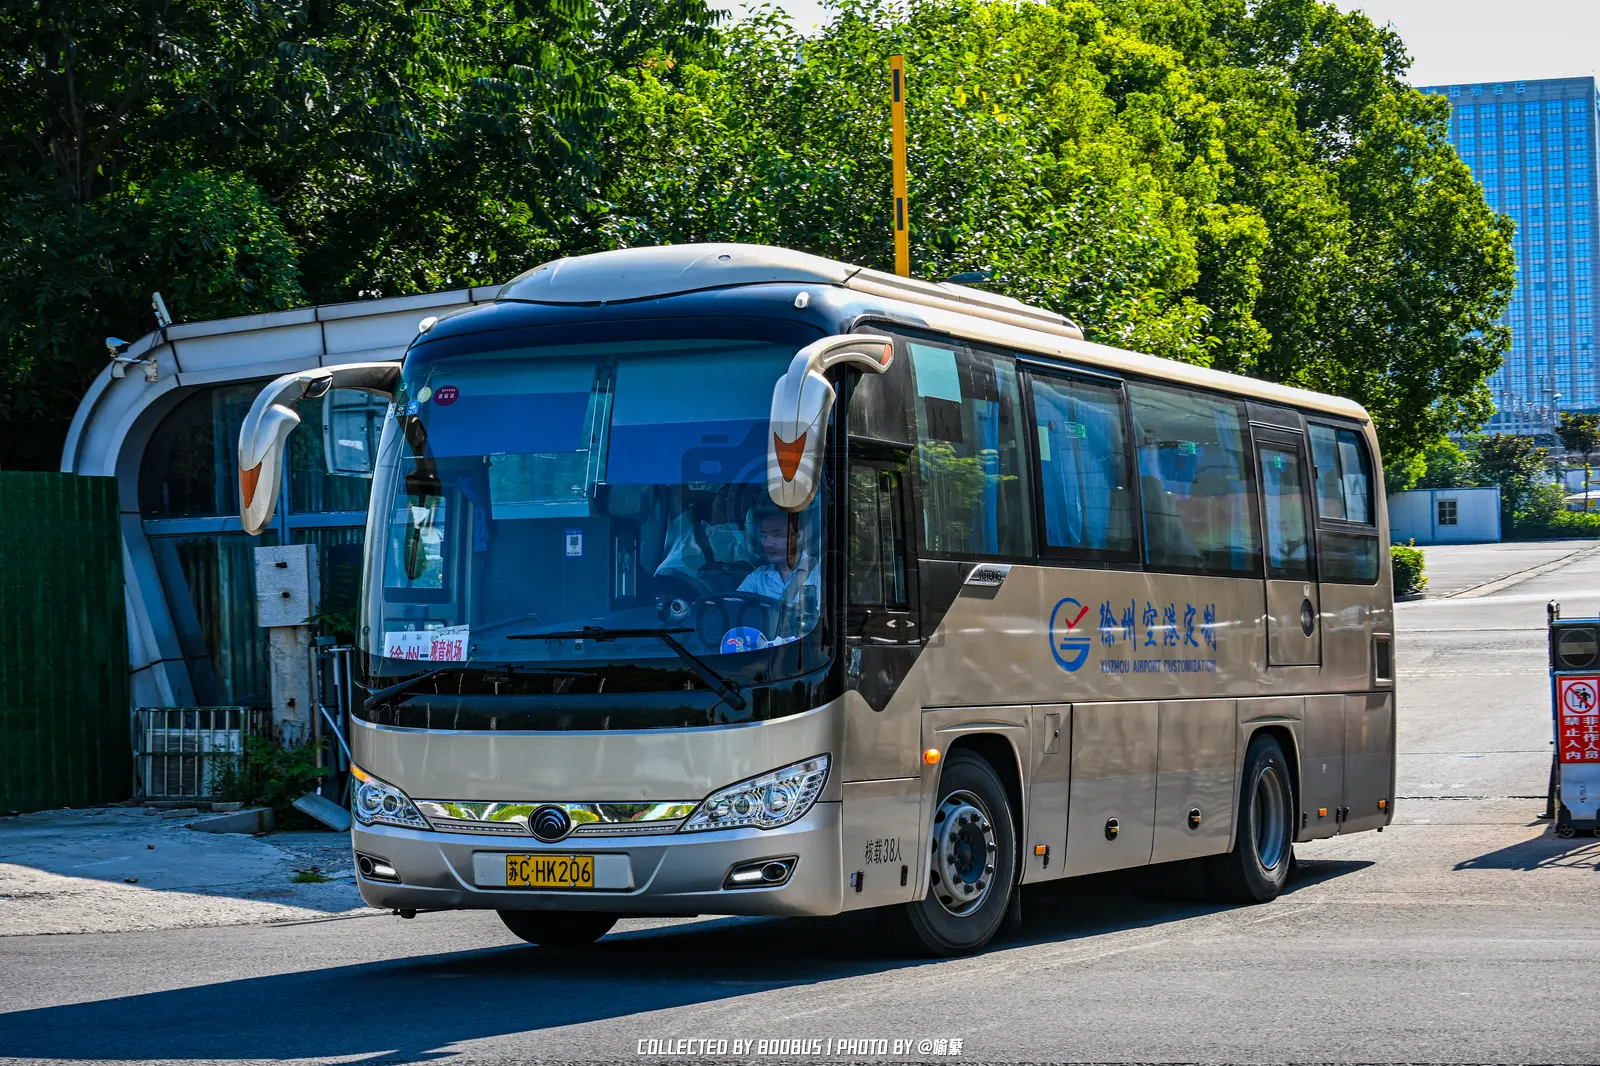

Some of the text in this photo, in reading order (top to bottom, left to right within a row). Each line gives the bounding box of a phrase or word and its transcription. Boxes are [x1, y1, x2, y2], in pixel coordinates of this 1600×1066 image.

[978, 569, 1003, 582] YUTONG
[1099, 598, 1217, 652] 徐州空港定制
[1100, 659, 1217, 674] XUZHOU AIRPORT CUSTOMIZATION
[1564, 716, 1582, 760] 禁止入内
[1583, 716, 1600, 759] 非工作人员
[865, 837, 902, 864] 核载38人
